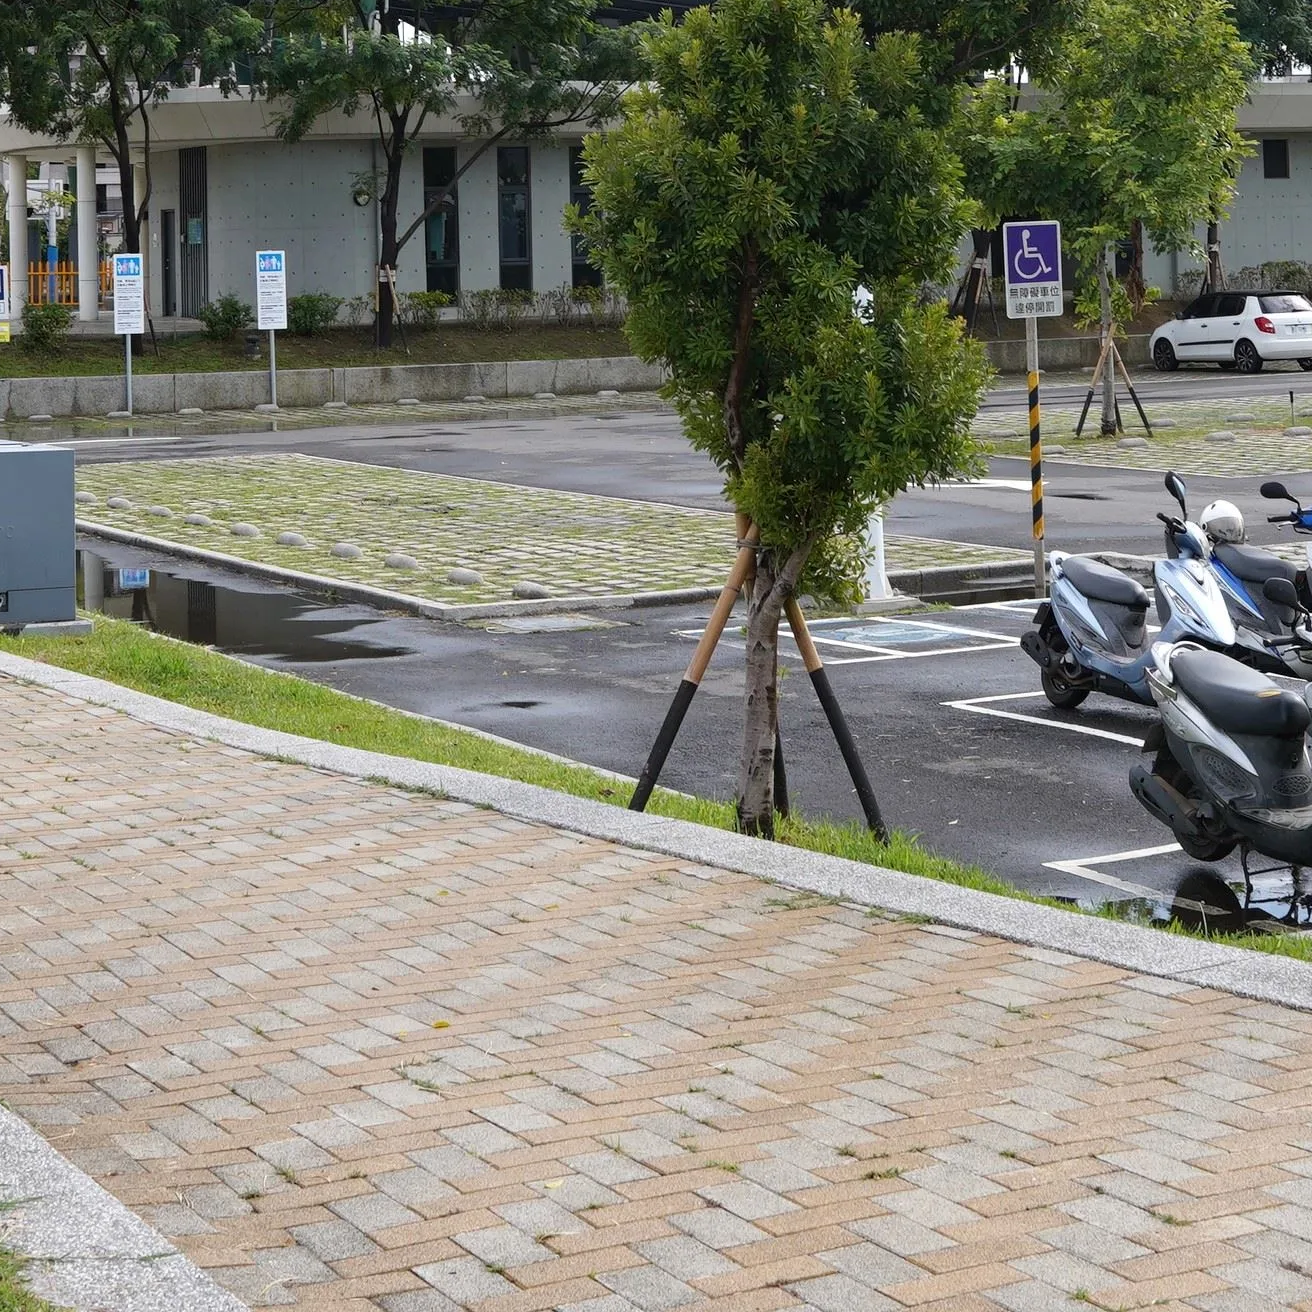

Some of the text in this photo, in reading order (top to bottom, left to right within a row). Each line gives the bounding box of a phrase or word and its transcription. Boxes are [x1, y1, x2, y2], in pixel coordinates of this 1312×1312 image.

[1009, 286, 1060, 299] 無障礙車位
